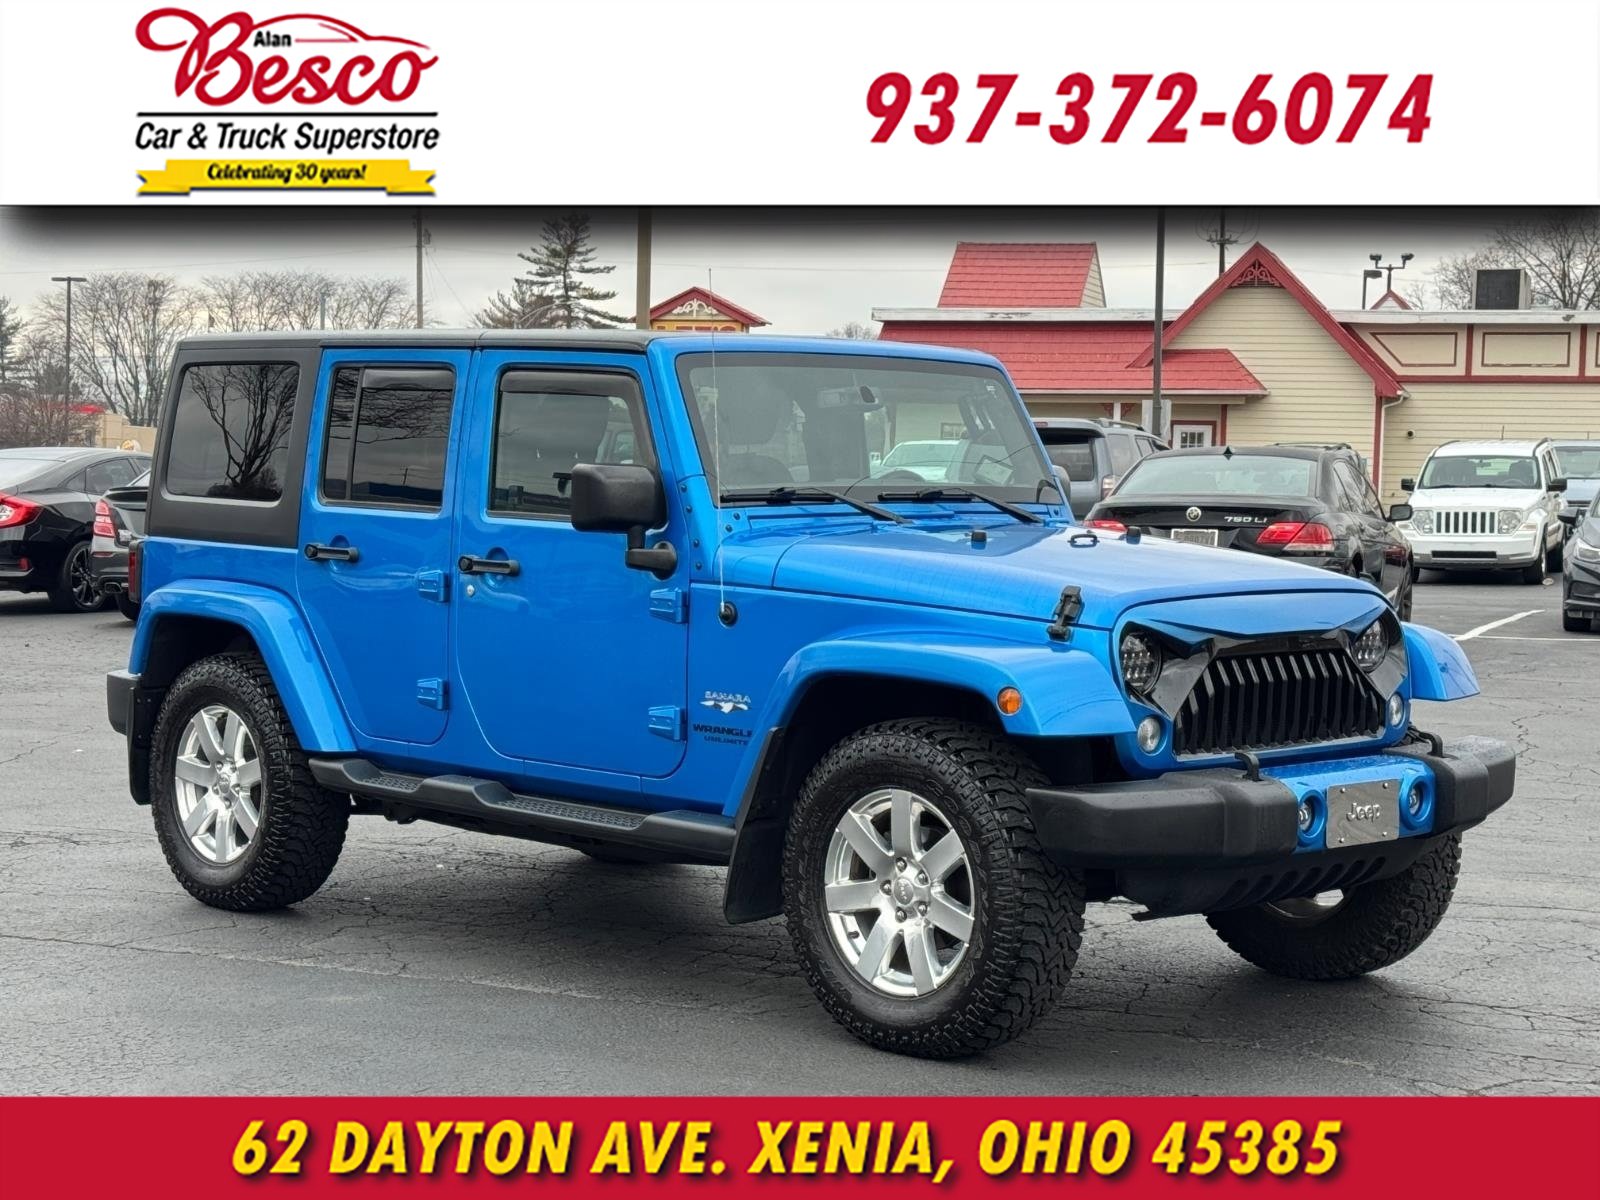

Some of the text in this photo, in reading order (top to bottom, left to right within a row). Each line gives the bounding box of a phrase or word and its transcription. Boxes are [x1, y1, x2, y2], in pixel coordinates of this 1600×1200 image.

[704, 690, 751, 703] SAHARA
[693, 724, 752, 737] WRANGLE
[1346, 802, 1381, 823] Jeep
